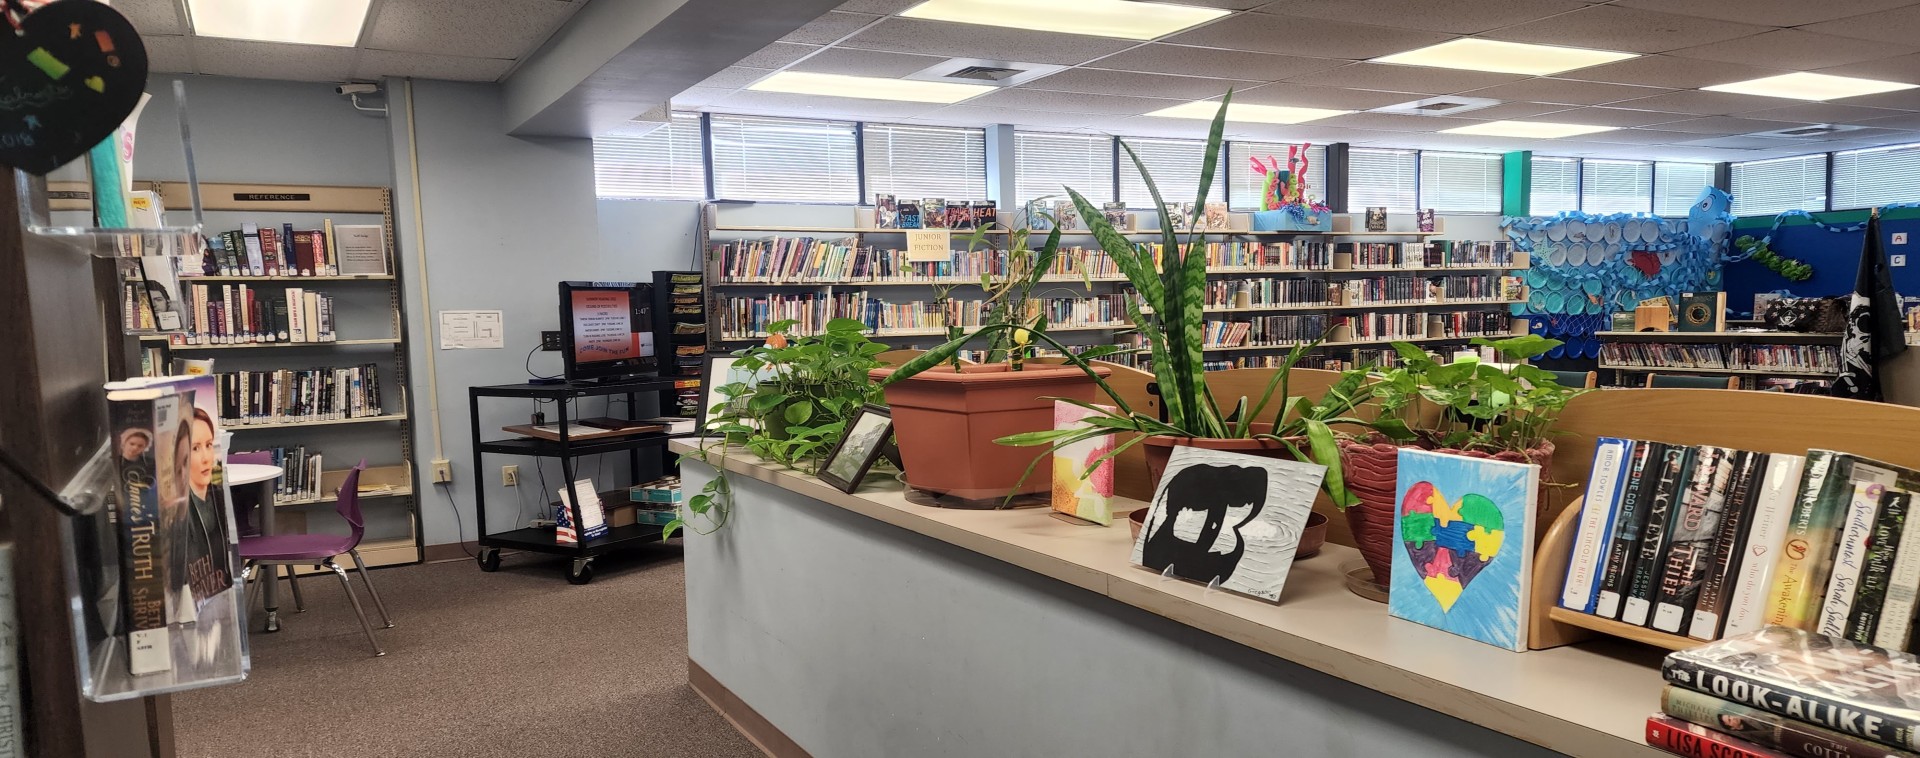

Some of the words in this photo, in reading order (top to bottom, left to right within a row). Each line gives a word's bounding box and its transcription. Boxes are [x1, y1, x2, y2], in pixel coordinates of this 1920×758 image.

[973, 207, 996, 217] HEAT
[224, 233, 233, 250] VINES
[264, 231, 272, 255] BIBLE
[915, 233, 942, 241] JUNIOR
[1894, 256, 1901, 264] C
[122, 465, 156, 523] Annie's
[1595, 475, 1609, 506] TOWLES
[1653, 477, 1674, 520] LACY
[1623, 493, 1637, 518] CODE
[1684, 483, 1712, 531] WARD
[1640, 522, 1663, 560] EYE
[1843, 501, 1873, 570] Southernmost
[1876, 525, 1892, 546] LOVE
[131, 520, 156, 580] TRUTH
[1613, 543, 1623, 566] KATHY
[1868, 550, 1884, 572] YOUR
[1882, 545, 1895, 562] How
[189, 554, 213, 586] BETH
[1607, 565, 1618, 588] REICHS
[1662, 545, 1695, 596] THIEF
[1680, 556, 1698, 586] THE
[1866, 575, 1878, 590] ELF
[1702, 581, 1712, 606] DEATH
[1835, 573, 1854, 607] Sarah
[1676, 699, 1712, 715] MICHAEL
[1696, 669, 1883, 740] LOOK-ALIKE
[1667, 729, 1703, 758] LISA
[1830, 743, 1848, 752] THE
